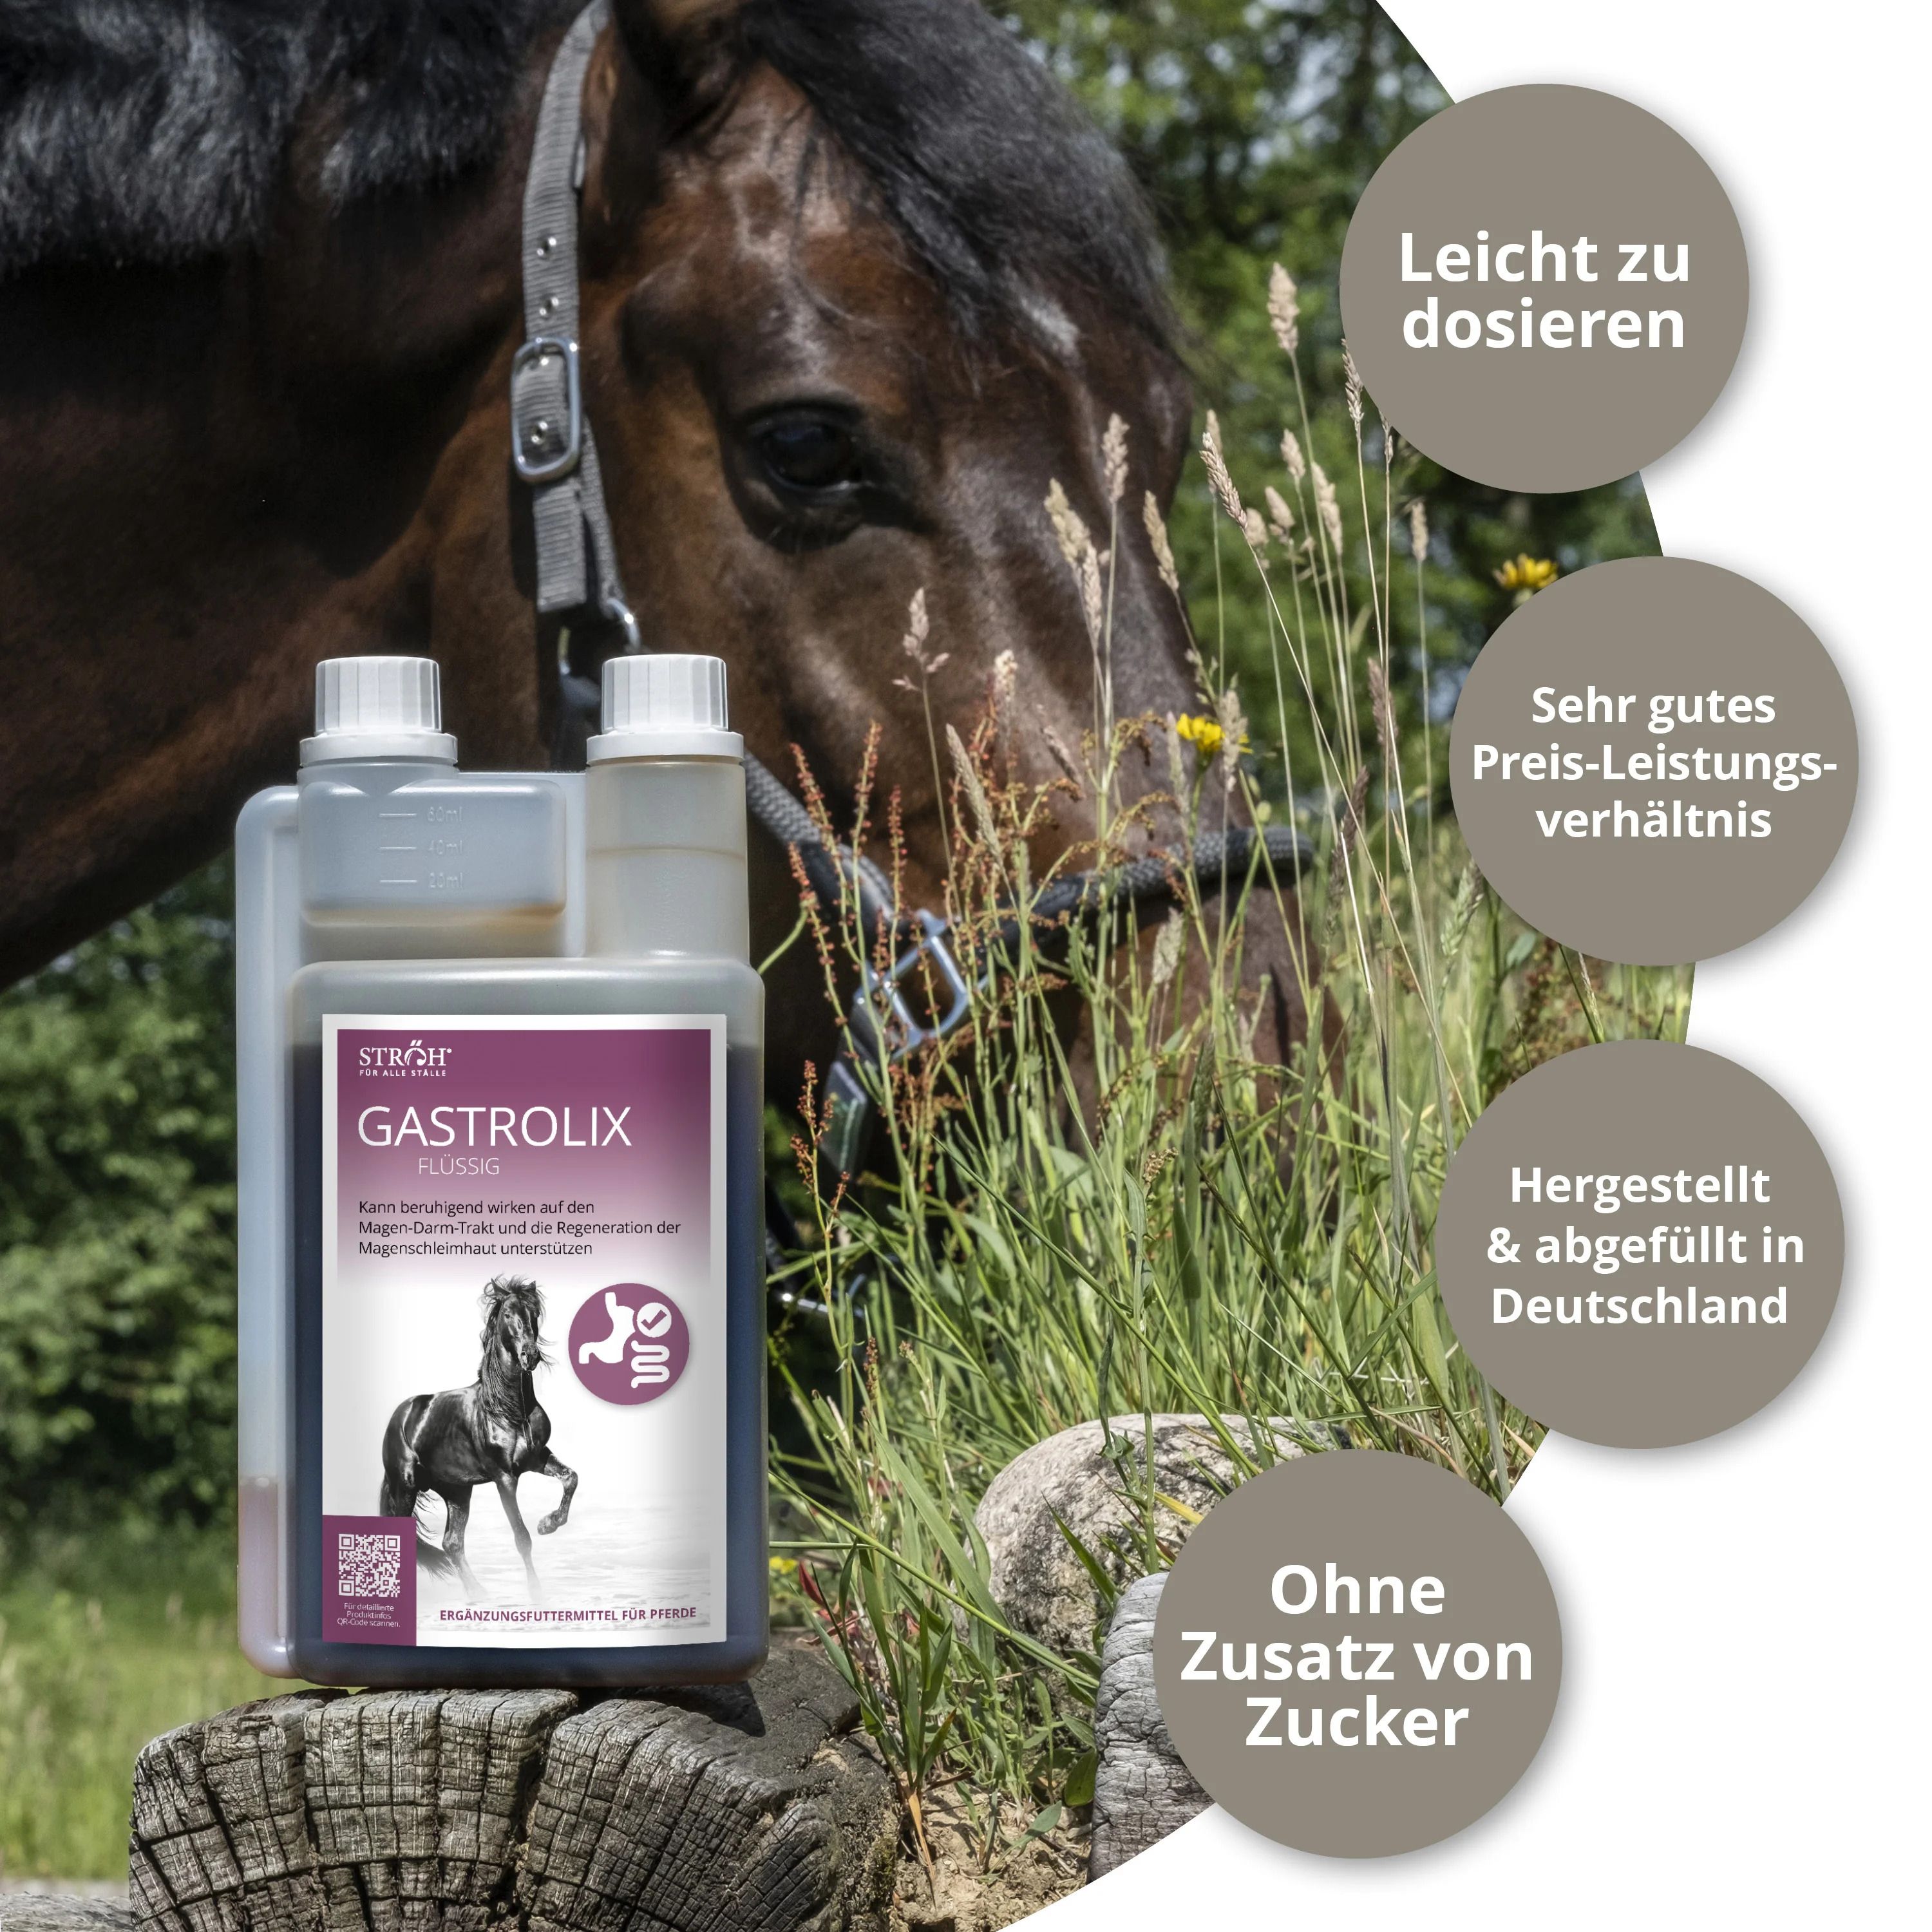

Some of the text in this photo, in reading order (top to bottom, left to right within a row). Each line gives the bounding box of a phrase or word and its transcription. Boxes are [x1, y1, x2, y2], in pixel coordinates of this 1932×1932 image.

[359, 1068, 378, 1077] FÜR
[411, 1068, 446, 1077] STÄLLE
[358, 1106, 632, 1147] GASTROLIX
[419, 1153, 499, 1175] FLÜSSIG
[359, 1200, 594, 1217] Kann beruhigend wirken auf den
[359, 1220, 681, 1238] Magen-Darm-Trakt und die Regeneration der
[359, 1241, 592, 1258] Magenschleimhaut unterstützen
[337, 1618, 368, 1626] QR-Code
[346, 1611, 392, 1619] Produktinfos
[440, 1607, 697, 1622] ERGÄNZUNGSFUTTERMITTEL FÜR PFERDE
